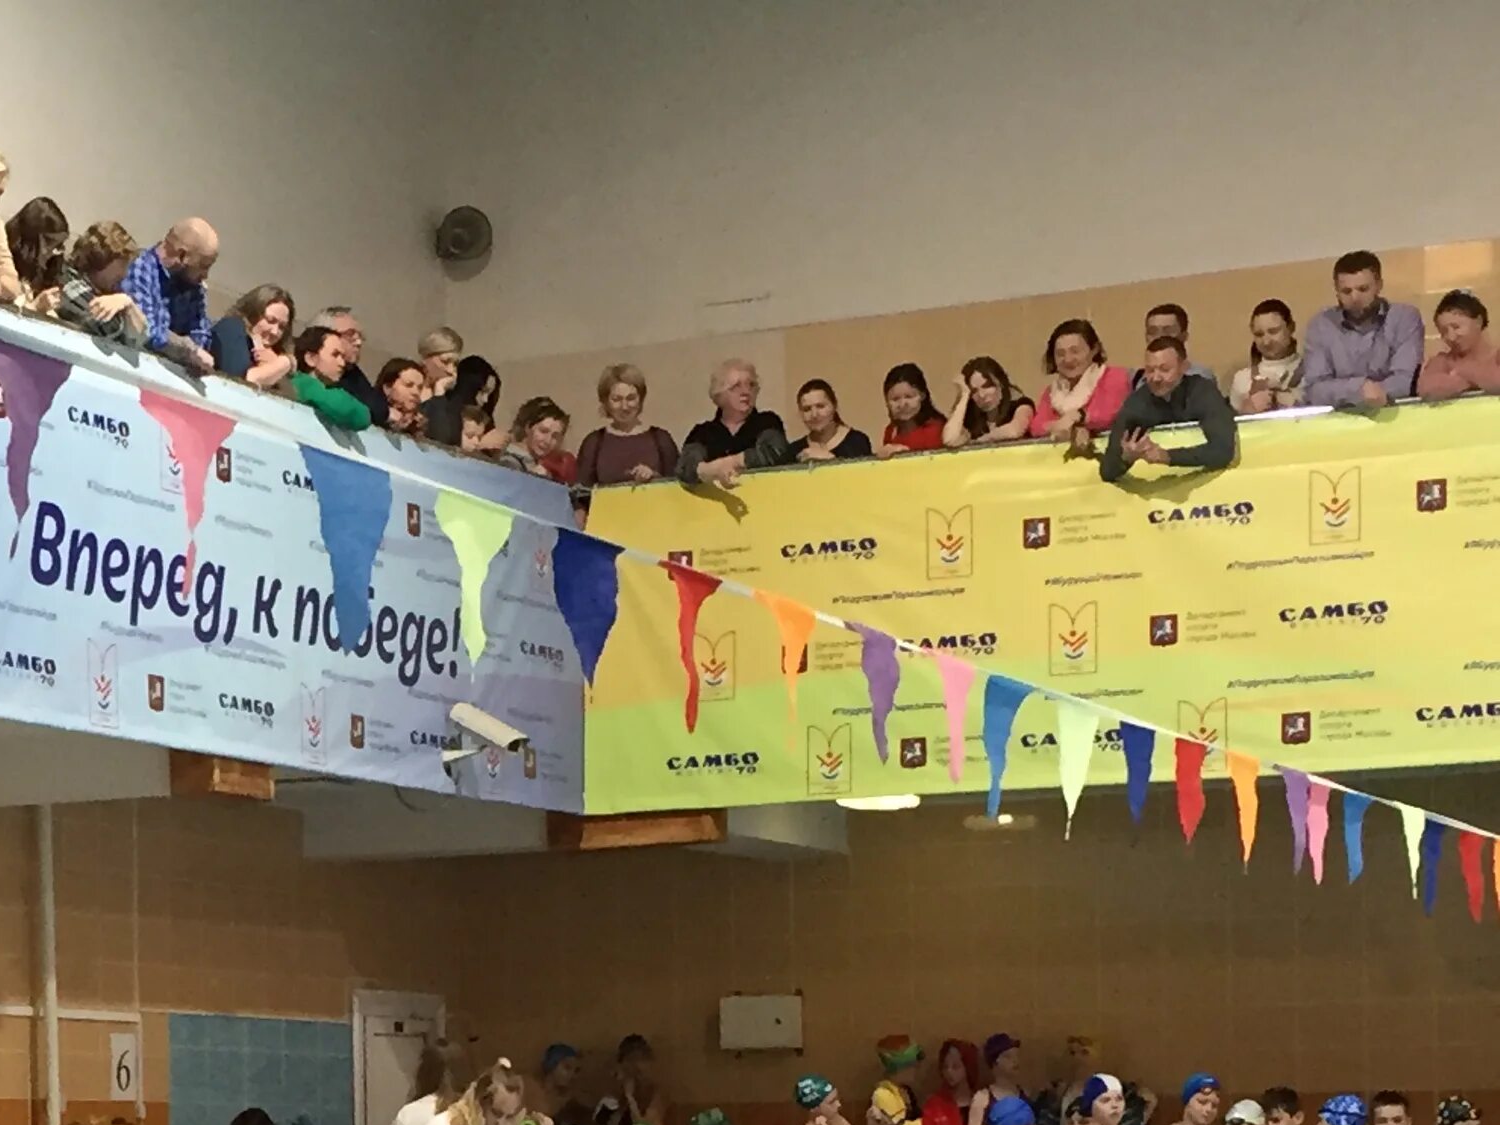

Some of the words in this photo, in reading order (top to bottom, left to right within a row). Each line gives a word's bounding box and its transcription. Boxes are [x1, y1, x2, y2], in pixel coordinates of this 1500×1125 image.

[67, 405, 130, 437] САМБО
[283, 470, 314, 492] САМ
[1148, 501, 1255, 525] САМБО
[1227, 517, 1251, 527] 70
[781, 537, 878, 558] САМБО
[853, 550, 876, 560] 70
[30, 501, 238, 645] Вперед,
[252, 576, 282, 638] к
[1279, 600, 1388, 623] САМБО
[1360, 614, 1386, 626] 70
[219, 692, 275, 717] САМБО
[1416, 701, 1500, 723] САМБ
[666, 751, 760, 771] САМБО
[736, 765, 758, 775] 70
[116, 1050, 132, 1092] 6
